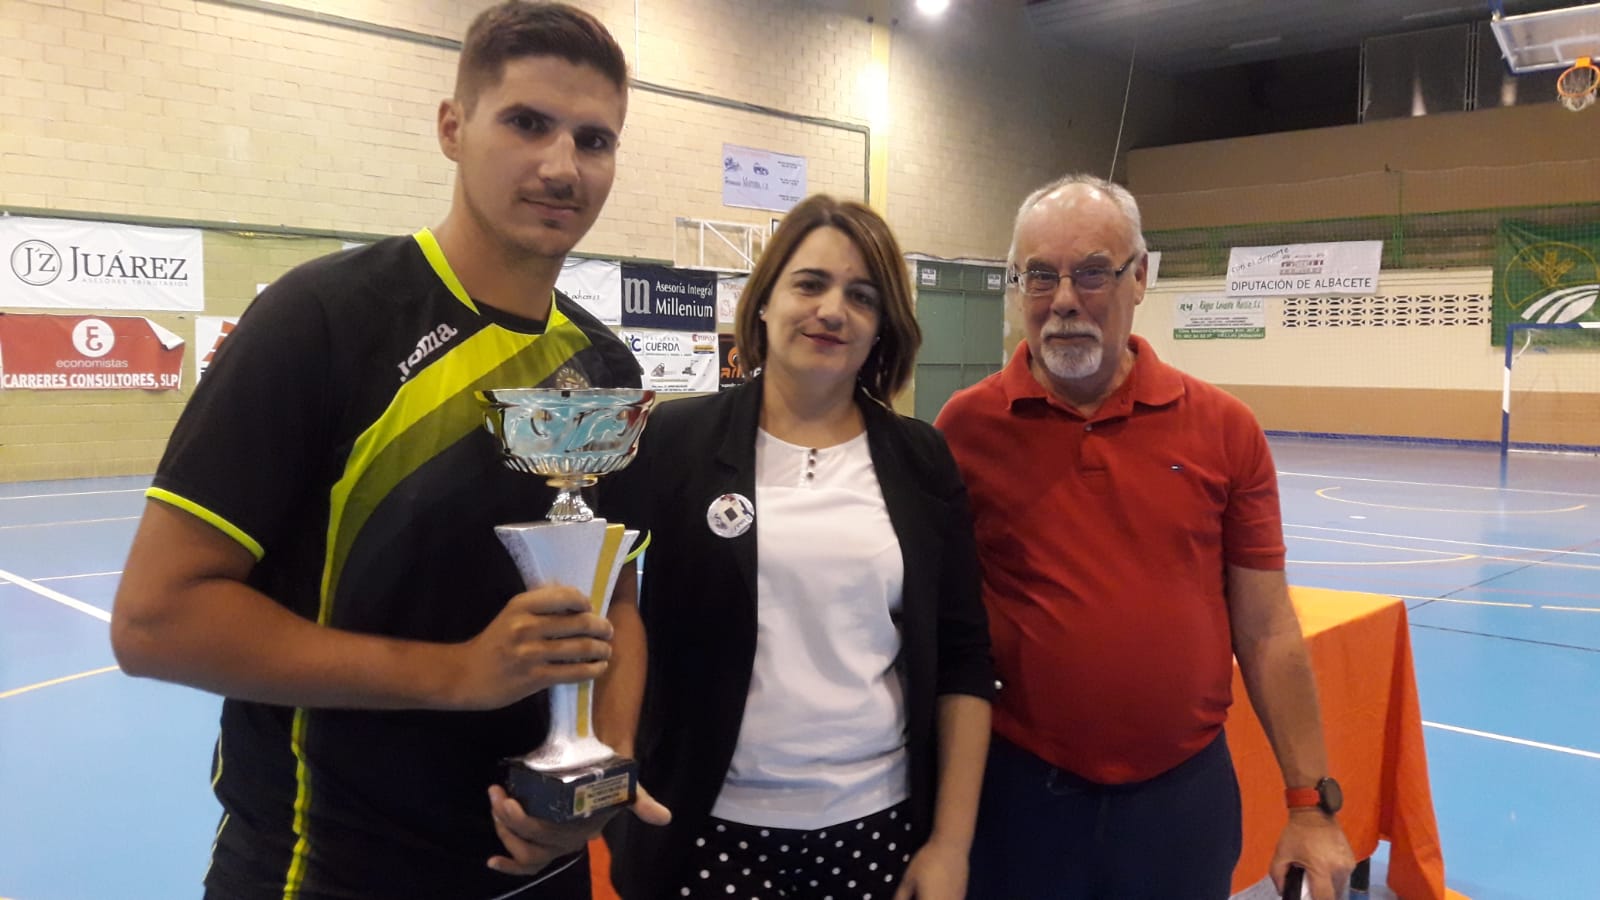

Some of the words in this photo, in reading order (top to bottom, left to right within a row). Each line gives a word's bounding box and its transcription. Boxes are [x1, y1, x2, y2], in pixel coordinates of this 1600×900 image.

[68, 246, 188, 282] JUÁREZ
[1231, 279, 1293, 291] DIPUTACIÓN
[1297, 279, 1311, 289] DE
[1314, 277, 1372, 288] ALBACETE
[655, 298, 713, 318] Millenium
[645, 342, 680, 352] CUERDA
[56, 358, 129, 368] economistas
[3, 373, 67, 388] CARRERES
[69, 373, 159, 388] CONSULTORES,
[160, 374, 179, 387] SLP
